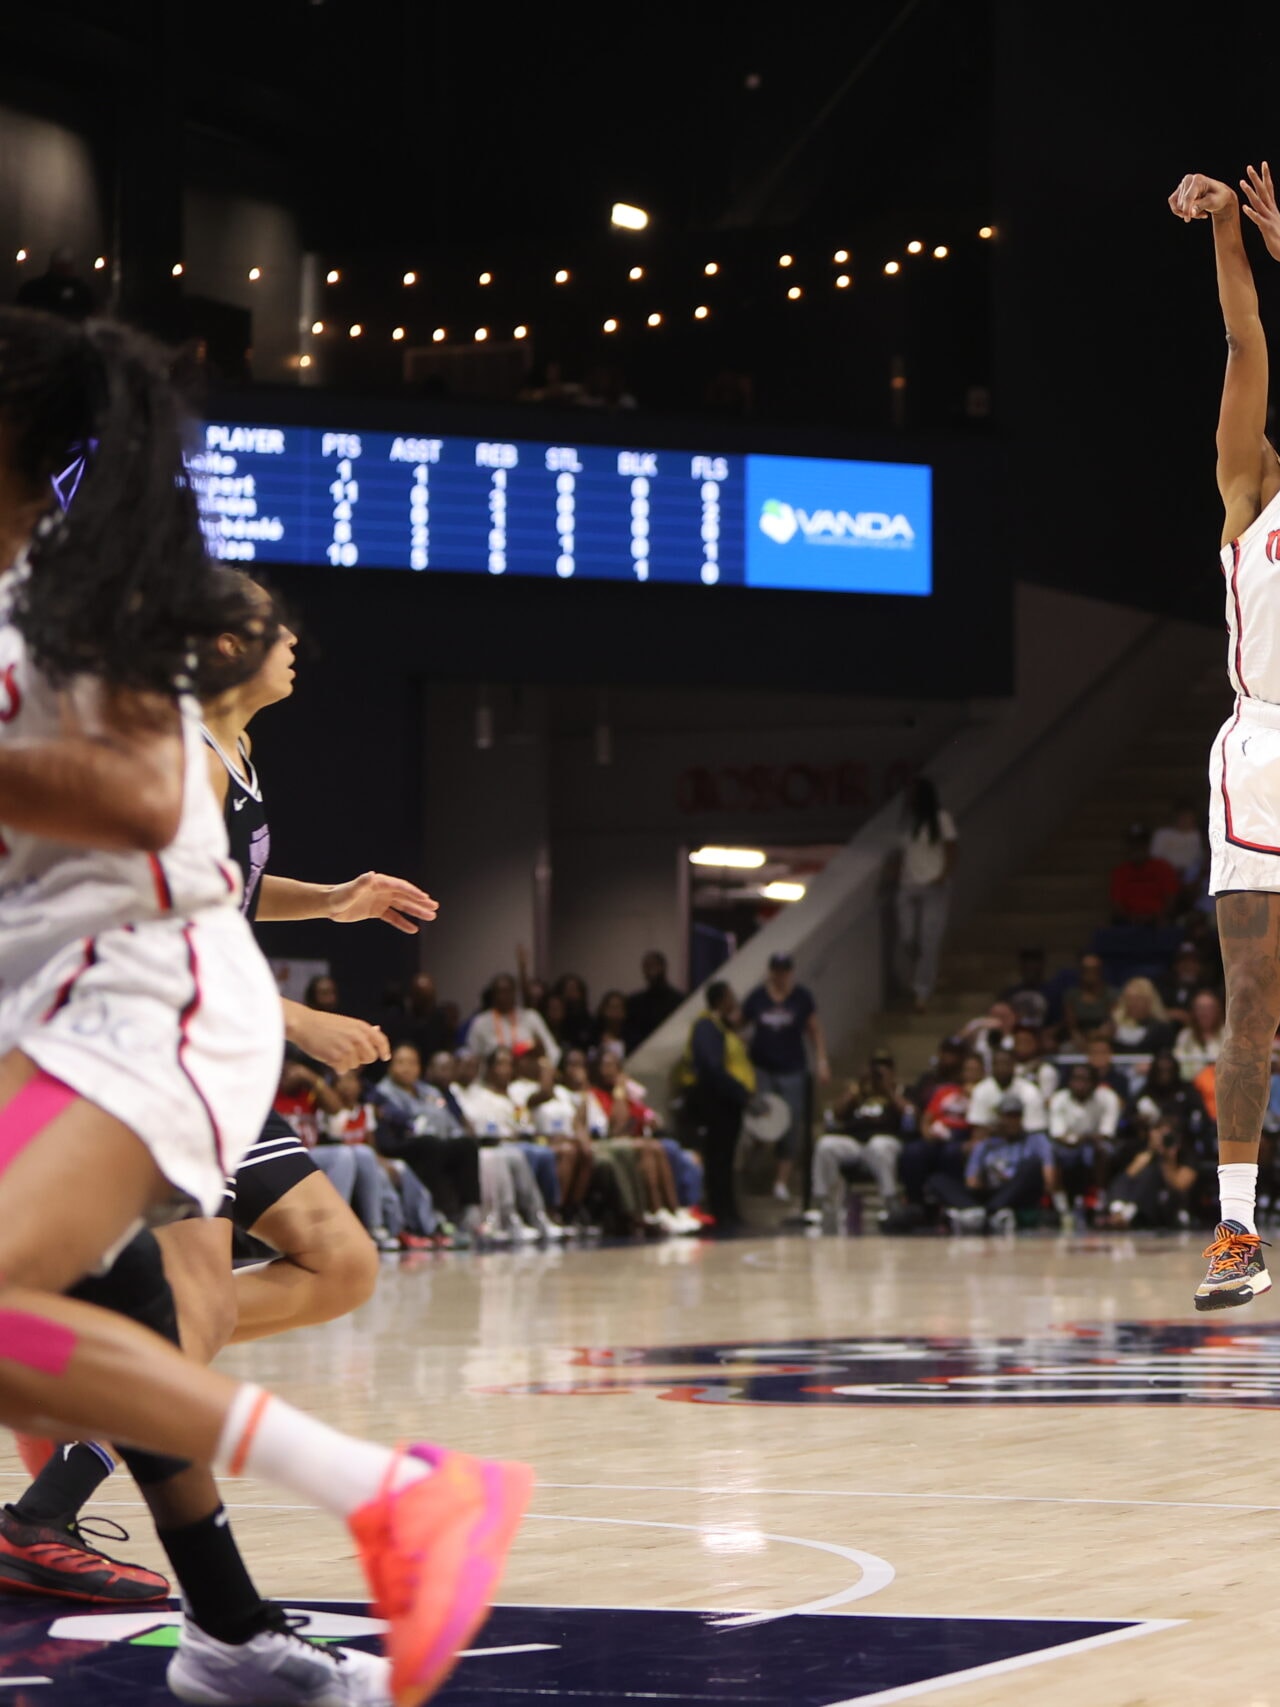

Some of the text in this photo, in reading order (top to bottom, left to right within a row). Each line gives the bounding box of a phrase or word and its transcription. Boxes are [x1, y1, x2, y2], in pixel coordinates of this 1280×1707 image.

[206, 425, 729, 481] PLAYER PTS ASST REB STL BLK FLS
[330, 480, 358, 504] 11
[410, 484, 429, 506] 0
[556, 493, 575, 515] 0
[631, 498, 649, 519] 0
[337, 459, 352, 482] 1
[413, 464, 429, 485] 1
[491, 468, 507, 490] 1
[556, 472, 575, 494] 0
[631, 477, 649, 499] 0
[701, 481, 720, 502] 0
[333, 500, 352, 520] 4
[410, 505, 429, 526] 0
[556, 514, 575, 535] 0
[631, 518, 649, 539] 0
[701, 522, 720, 543] 0
[795, 508, 915, 541] VANDA
[326, 542, 358, 567] 10
[556, 554, 575, 578] 0
[633, 558, 649, 581] 1
[701, 561, 720, 585] 0
[558, 534, 574, 555] 1
[631, 538, 649, 560] 0
[703, 541, 718, 562] 1
